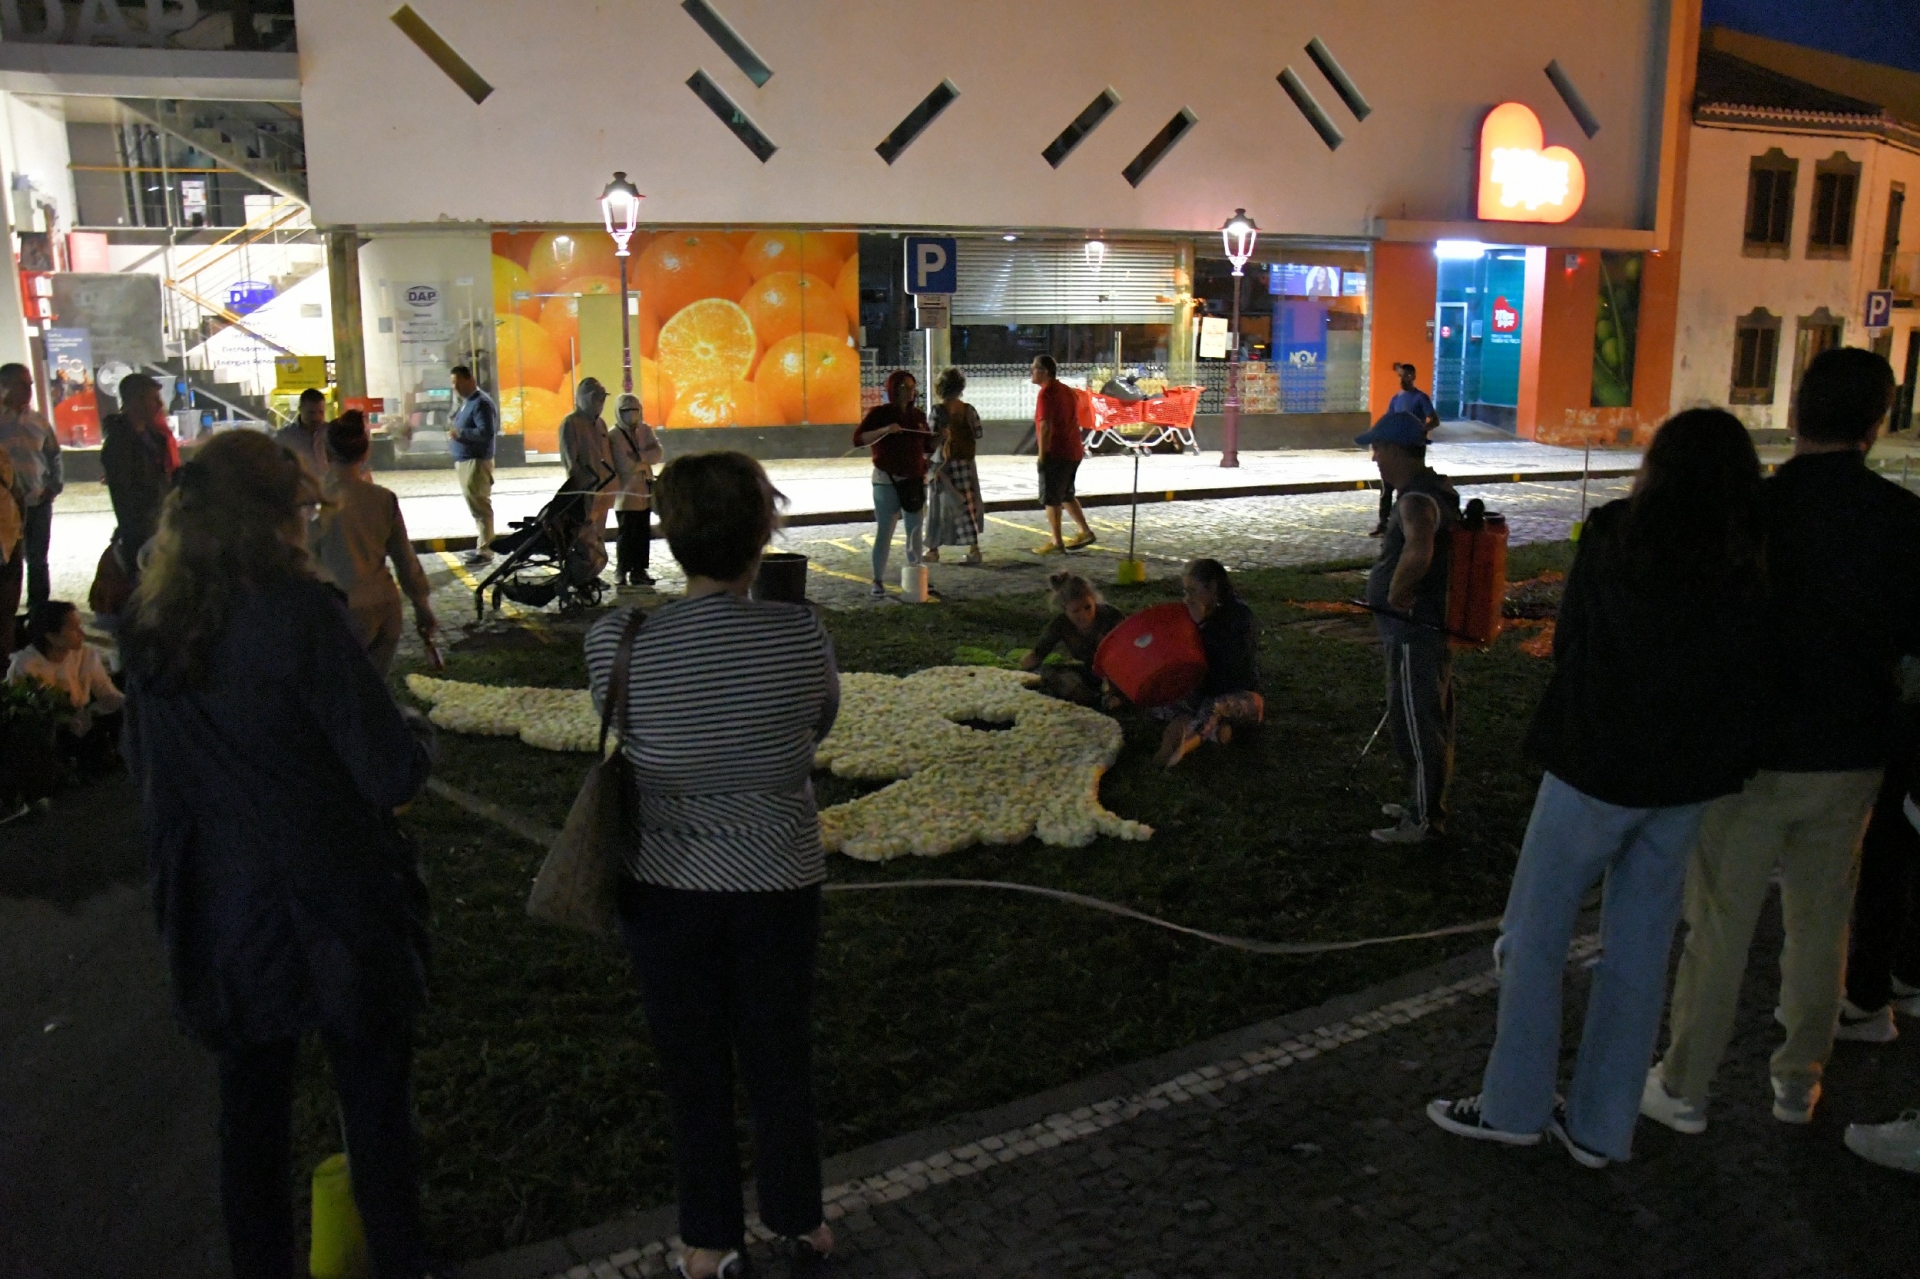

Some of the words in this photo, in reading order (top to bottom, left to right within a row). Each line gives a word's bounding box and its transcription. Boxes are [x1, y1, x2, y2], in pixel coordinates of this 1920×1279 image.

[917, 243, 947, 287] P
[408, 291, 436, 302] DAP
[1868, 295, 1887, 325] P
